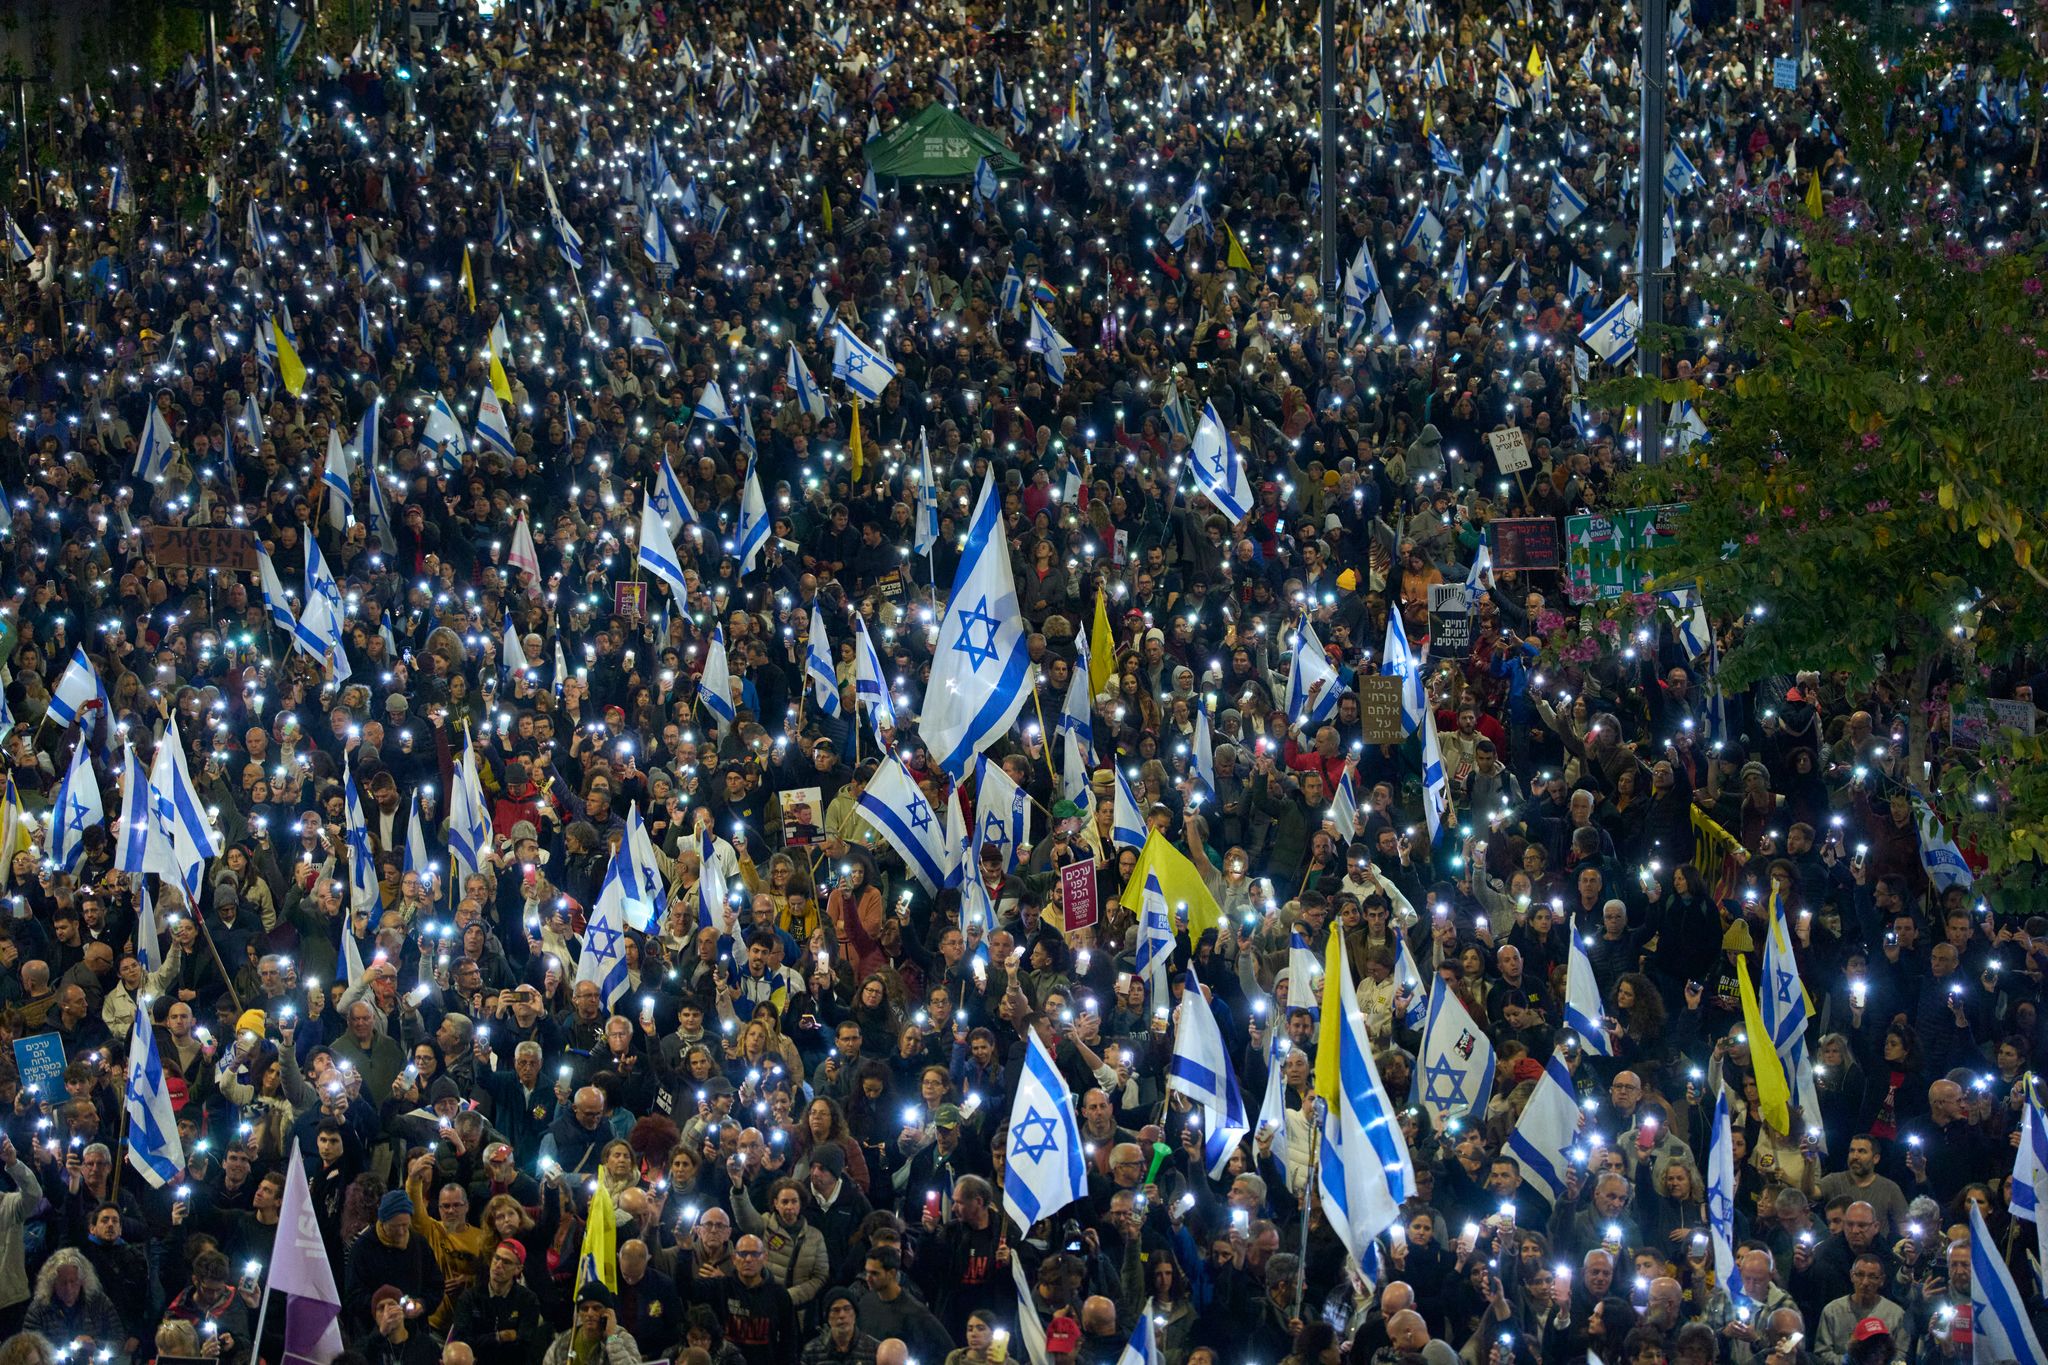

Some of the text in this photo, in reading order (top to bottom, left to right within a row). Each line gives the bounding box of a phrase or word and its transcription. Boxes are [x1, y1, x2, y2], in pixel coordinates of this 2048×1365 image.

[1434, 637, 1469, 649] מוקרטים.
[1370, 679, 1392, 689] בעל
[1368, 693, 1398, 703] כורחי
[1368, 705, 1400, 715] אלחם
[1376, 718, 1392, 728] על
[1066, 865, 1091, 880] ערכים
[1071, 876, 1088, 889] לפני
[1071, 888, 1088, 900] הכל
[25, 1040, 49, 1051] ערכים
[33, 1049, 46, 1058] הם
[31, 1056, 51, 1066] הרוח
[24, 1062, 61, 1075] במפרשים
[47, 1069, 60, 1077] של
